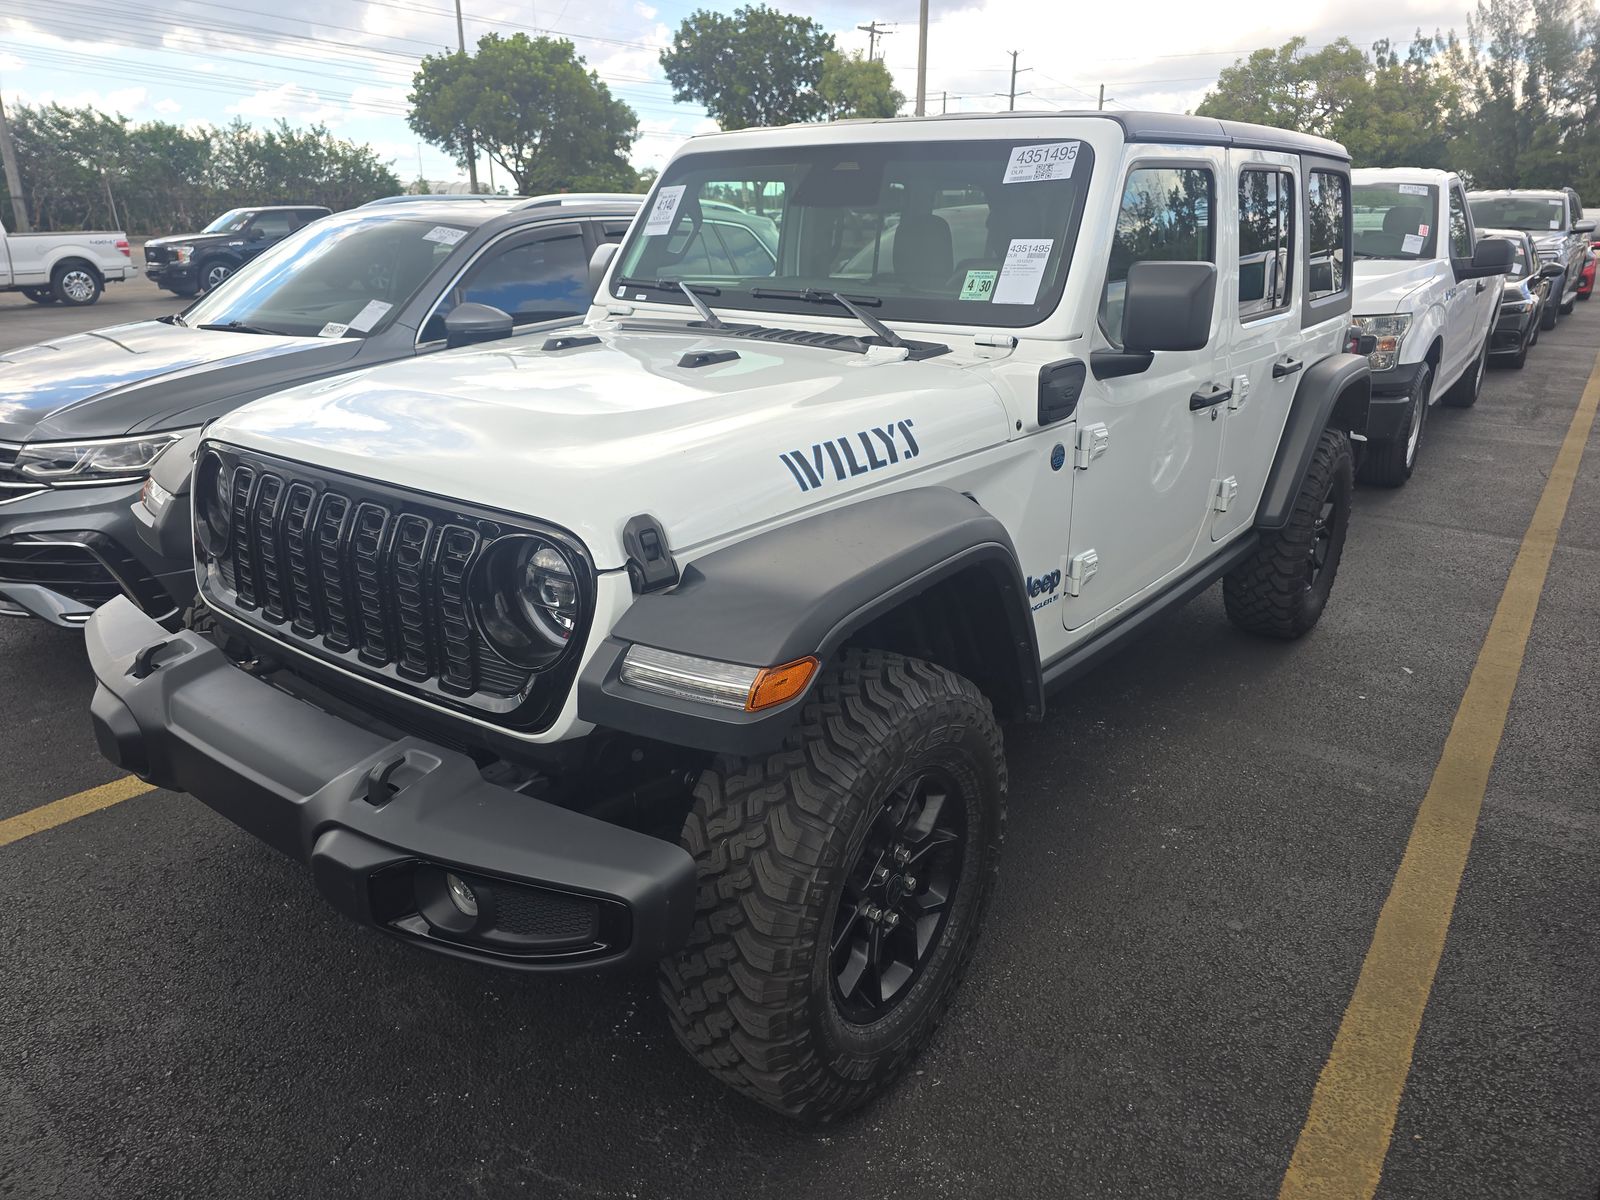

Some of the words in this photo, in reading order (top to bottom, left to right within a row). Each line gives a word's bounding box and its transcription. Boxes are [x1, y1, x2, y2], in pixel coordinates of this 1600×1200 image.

[1016, 146, 1077, 164] 4351495
[1010, 244, 1051, 253] 4351495
[967, 279, 975, 291] 4
[979, 280, 992, 292] 30
[779, 418, 919, 492] WILLYS
